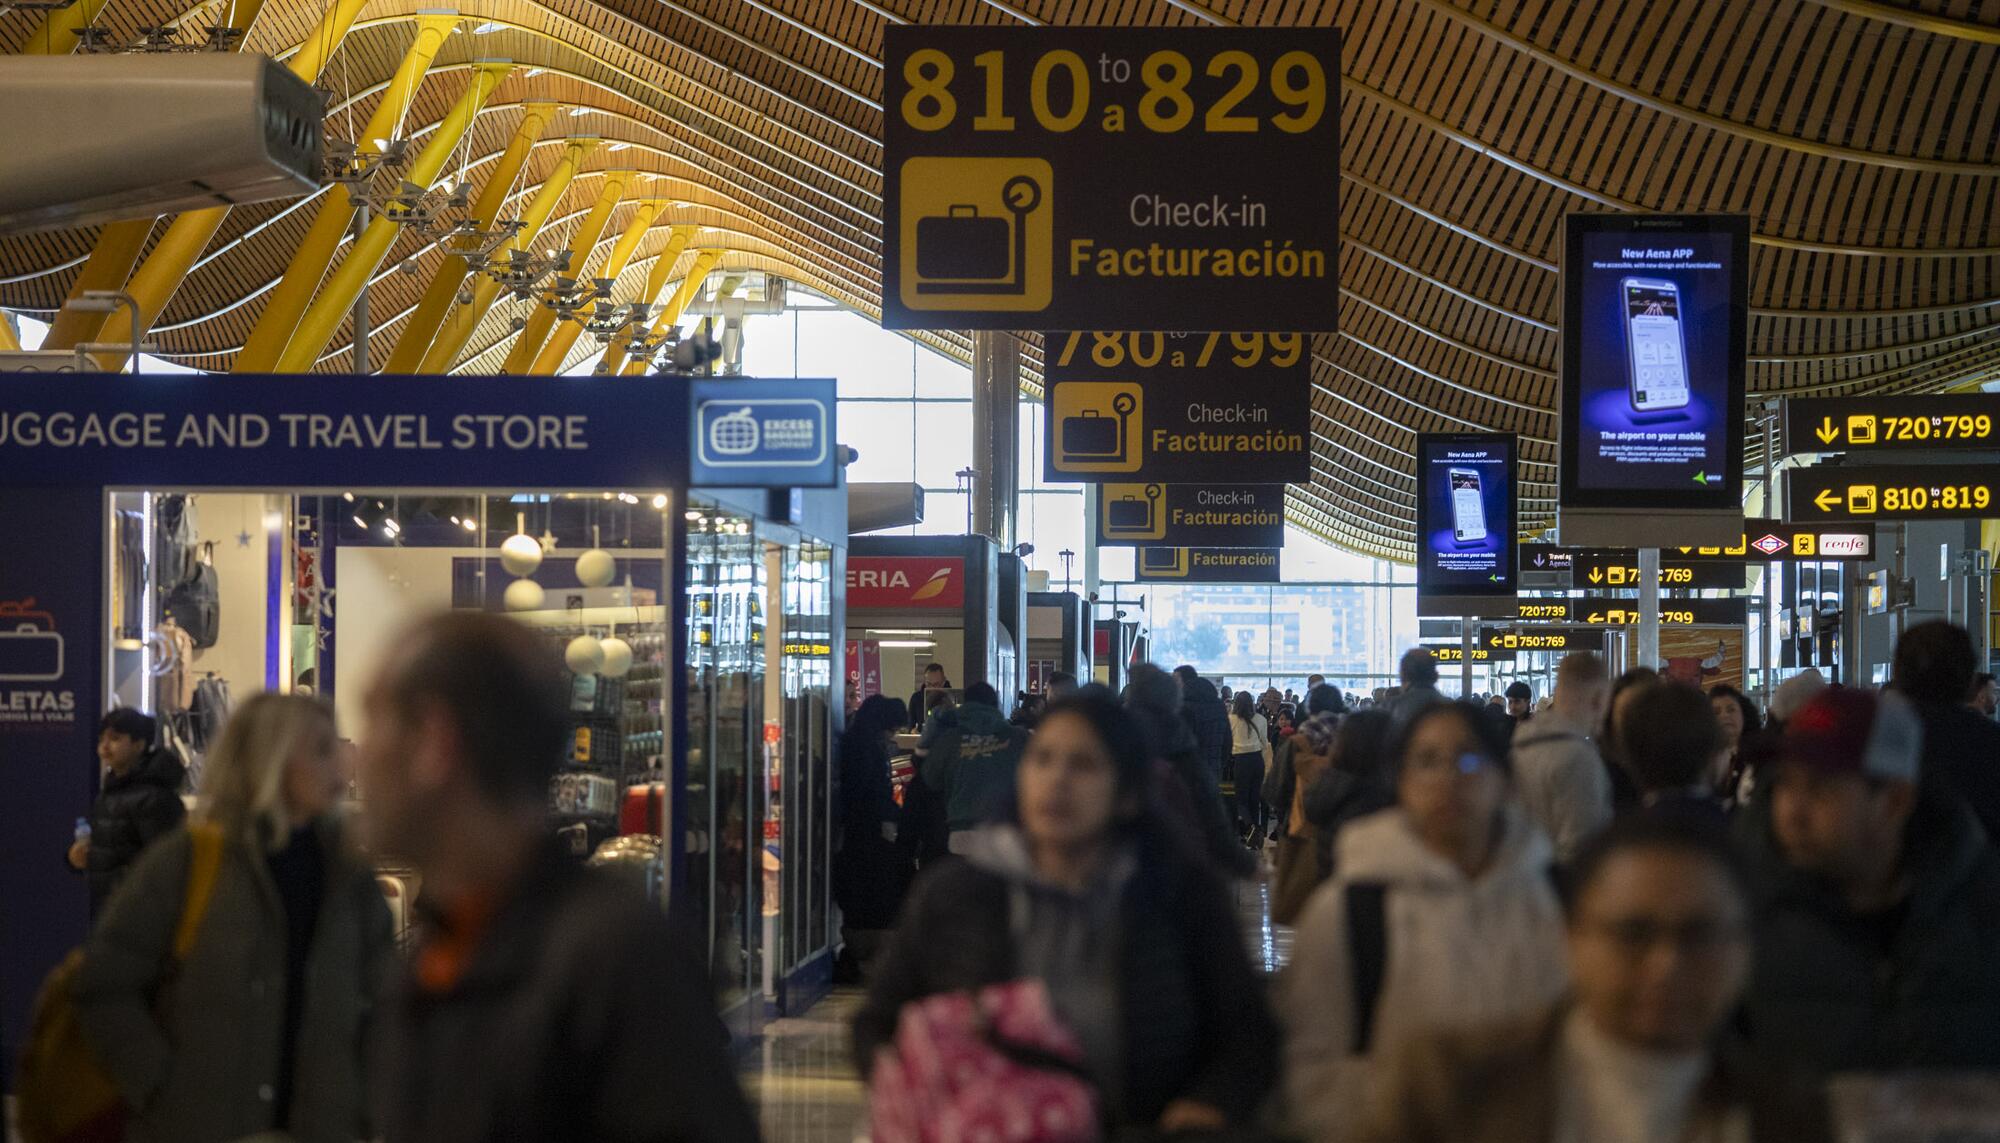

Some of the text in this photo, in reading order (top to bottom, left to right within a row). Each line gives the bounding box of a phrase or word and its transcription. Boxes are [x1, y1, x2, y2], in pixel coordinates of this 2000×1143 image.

[901, 48, 1327, 134] 810 to a 829
[1130, 193, 1266, 227] Check-in
[1070, 239, 1325, 278] Facturación
[1622, 248, 1694, 259] New Aena APP
[1057, 331, 1303, 368] 780 a 799
[1187, 403, 1268, 423] Check-in
[175, 413, 270, 448] AND
[279, 414, 442, 448] TRAVEL
[452, 415, 588, 449] STORE
[1882, 415, 1991, 440] 720 to a 799
[1152, 429, 1303, 452] Facturación
[1617, 432, 1645, 441] airport
[1658, 433, 1677, 442] your
[1678, 432, 1706, 440] mobile
[1197, 490, 1255, 505] Check-in
[1883, 486, 1991, 510] 810 to a 819
[1172, 508, 1279, 525] Facturación
[1825, 537, 1865, 552] renfe
[1193, 552, 1276, 566] Facturación
[1665, 568, 1693, 582] 769
[1519, 606, 1540, 617] 720
[1545, 606, 1566, 617] 739
[1664, 611, 1694, 624] 799
[1519, 636, 1540, 647] 750
[1545, 636, 1565, 647] 769
[1451, 650, 1462, 659] 72
